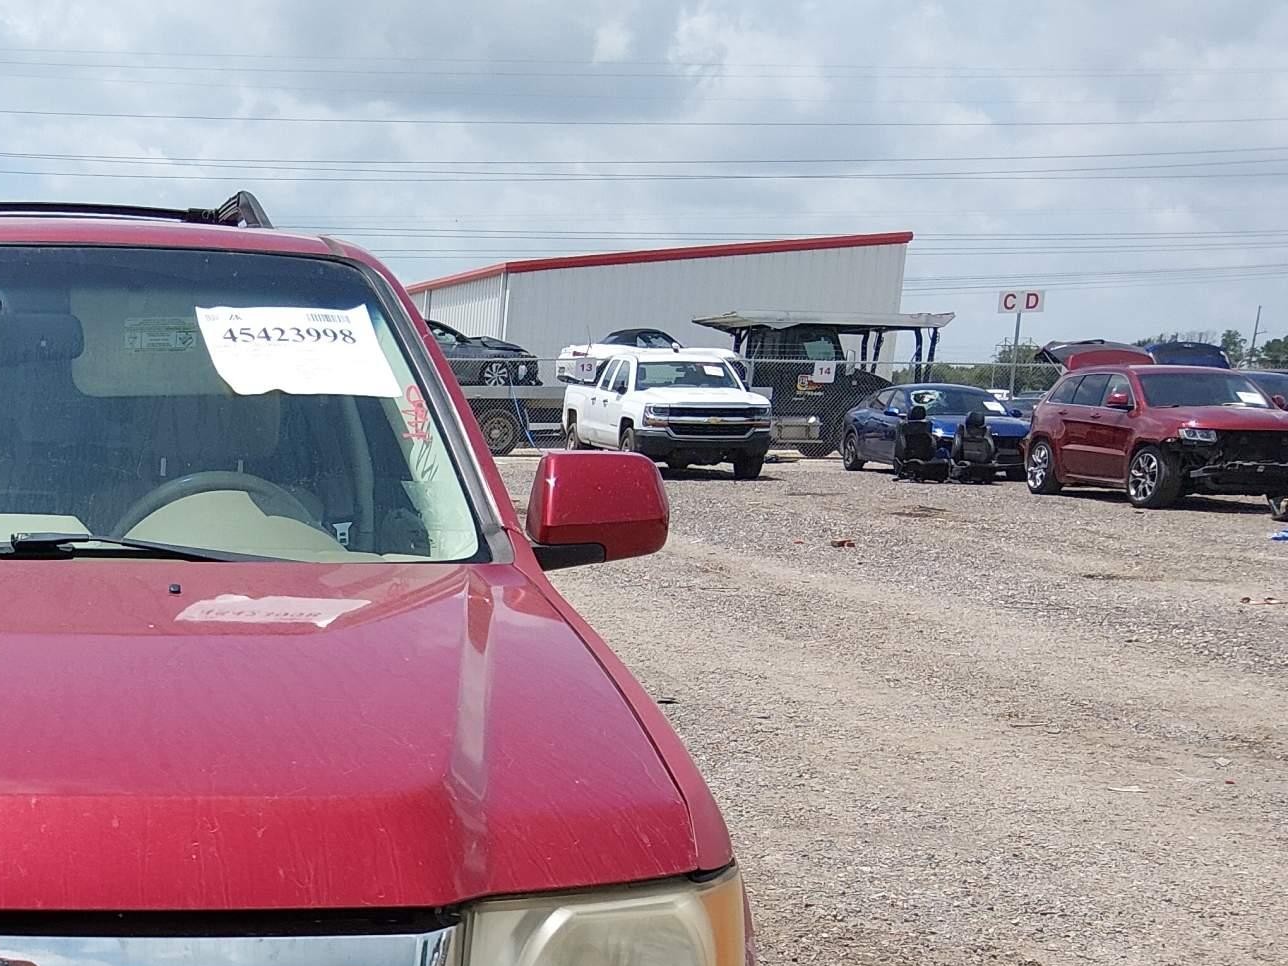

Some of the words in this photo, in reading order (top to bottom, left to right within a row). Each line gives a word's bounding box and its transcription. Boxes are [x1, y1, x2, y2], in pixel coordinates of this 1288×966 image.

[1004, 293, 1016, 310] C
[1025, 293, 1039, 309] D
[223, 327, 357, 345] 45423998
[580, 364, 593, 372] 13
[819, 367, 831, 375] 14
